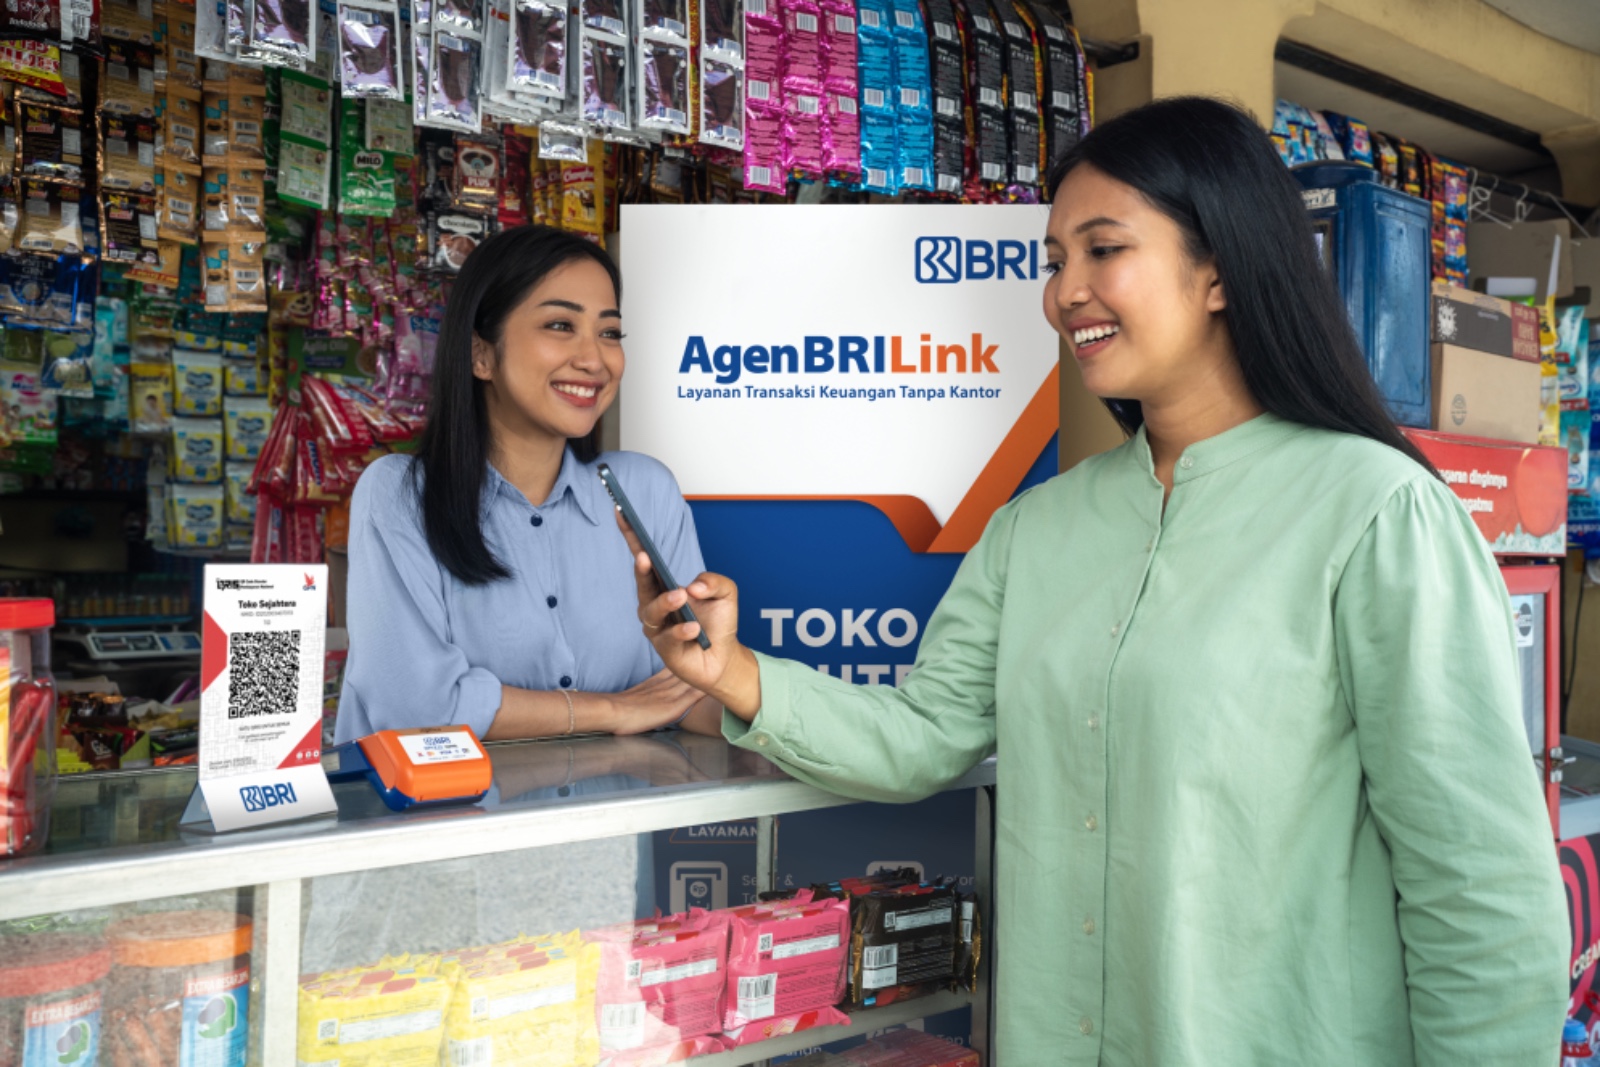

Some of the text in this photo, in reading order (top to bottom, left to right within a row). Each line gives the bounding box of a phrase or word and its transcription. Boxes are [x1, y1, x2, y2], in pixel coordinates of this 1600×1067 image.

[356, 155, 381, 167] MILO
[468, 177, 490, 188] PLUS
[965, 239, 1038, 280] BRI
[678, 333, 1000, 384] AgenBRILink
[677, 385, 1001, 402] Layanan Transaksi Keuangan Tanpa Kantor
[1469, 469, 1508, 490] dinginnya
[238, 599, 297, 611] Toko Sejahtera
[760, 608, 918, 648] TOKO
[263, 782, 298, 807] BRI
[688, 826, 758, 837] LAYANAN
[784, 873, 795, 886] &
[31, 1006, 63, 1024] EXTRA
